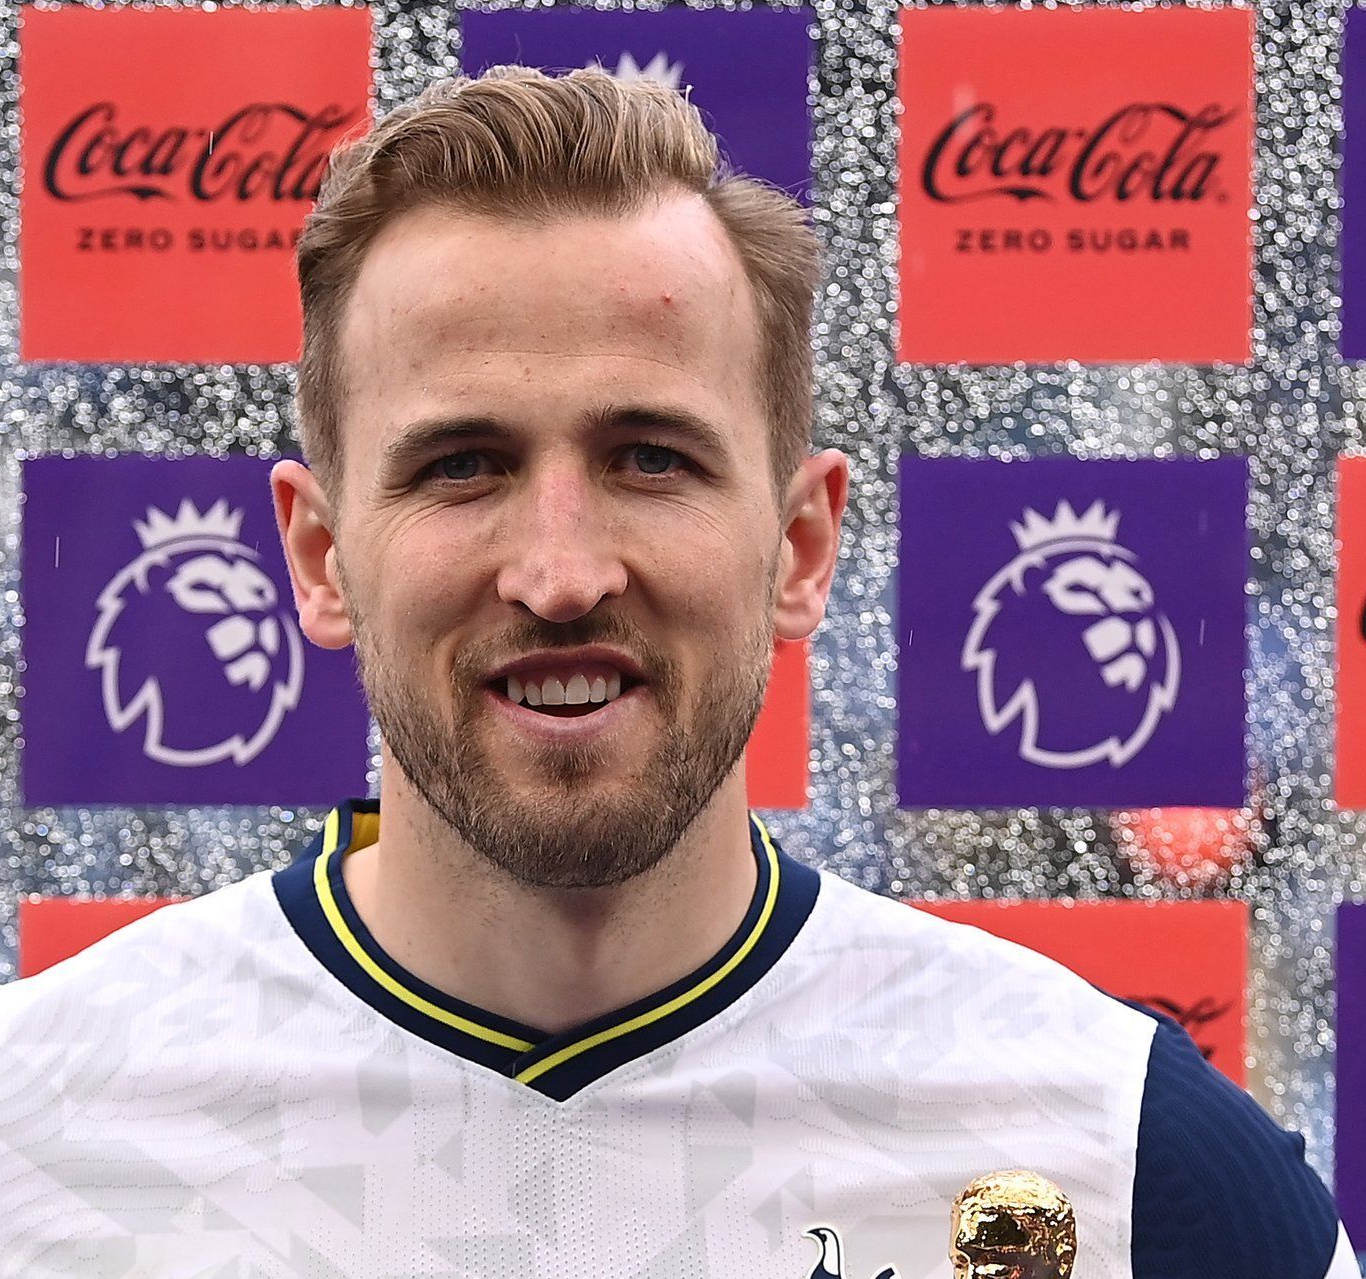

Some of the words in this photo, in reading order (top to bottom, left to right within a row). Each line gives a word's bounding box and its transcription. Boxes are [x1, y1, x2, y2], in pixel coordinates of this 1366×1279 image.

[919, 102, 1236, 204] Coca-Cola
[77, 228, 173, 252] ZERO
[956, 229, 1052, 253] ZERO
[1067, 229, 1190, 253] SUGAR
